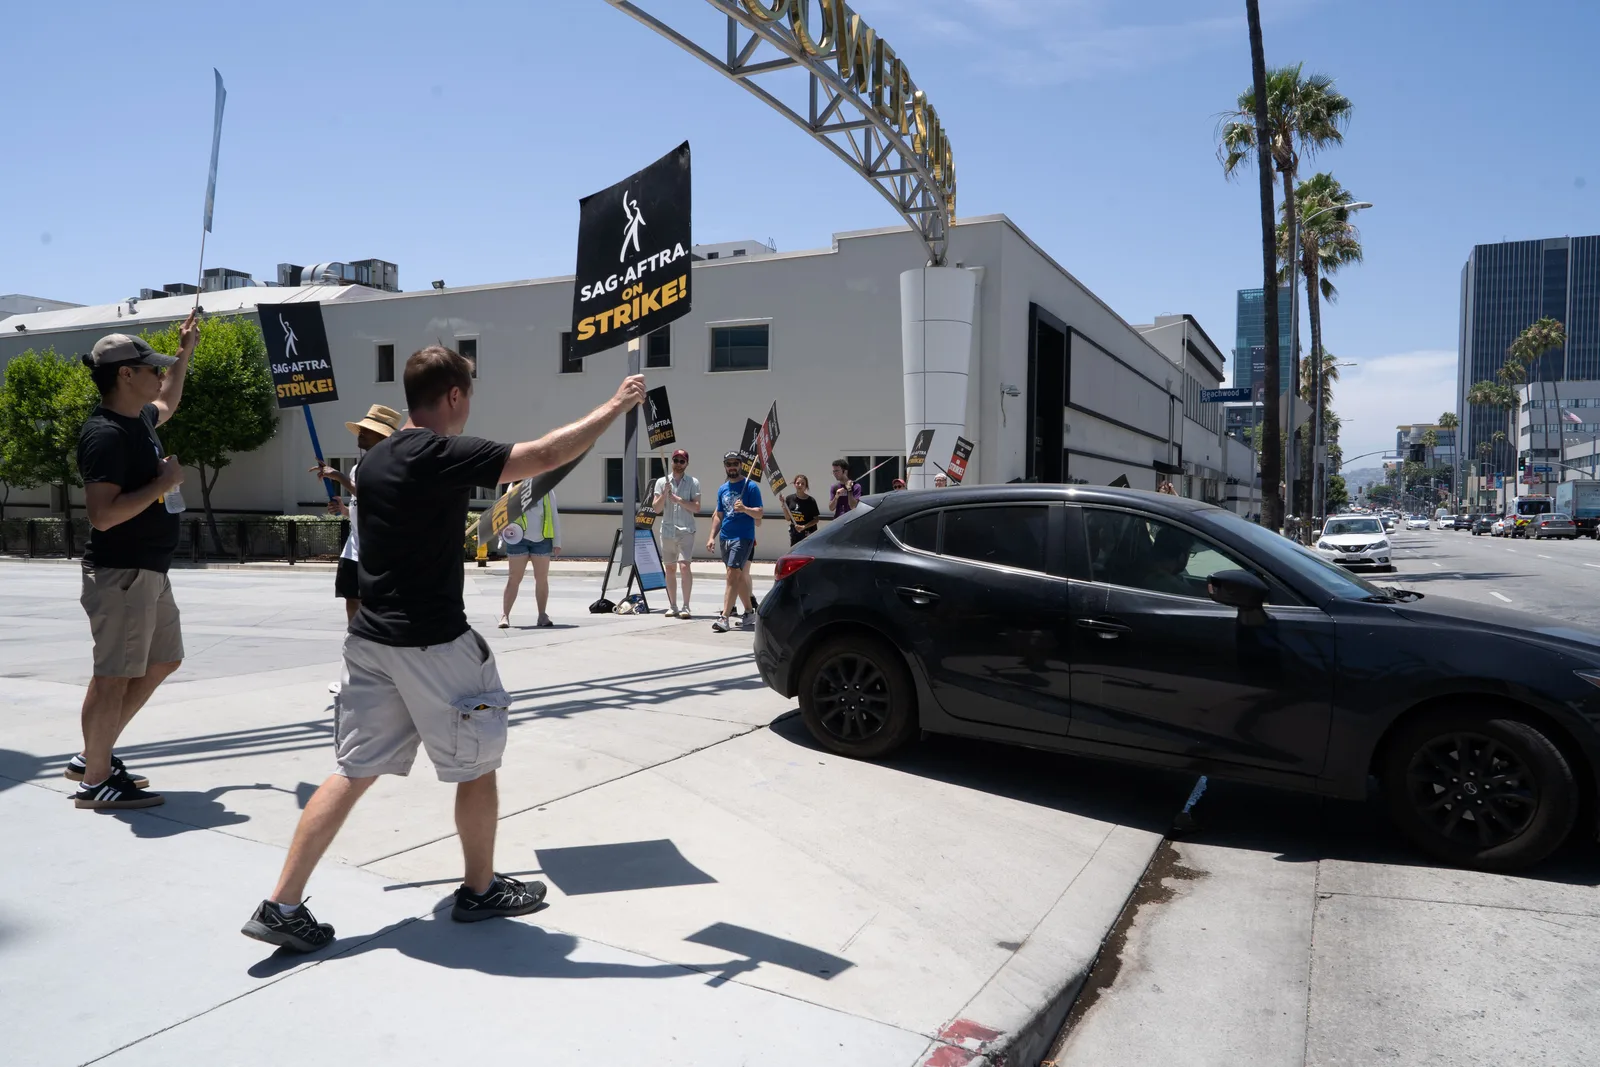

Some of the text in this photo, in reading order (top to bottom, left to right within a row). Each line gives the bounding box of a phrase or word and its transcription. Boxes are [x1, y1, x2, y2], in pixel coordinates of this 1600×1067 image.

[741, 0, 912, 136] OWER
[622, 281, 643, 300] ON
[577, 274, 687, 341] STRIKE!
[276, 378, 334, 398] STRIKE!
[1201, 389, 1240, 398] Beachwood
[650, 430, 674, 444] STRIKE!
